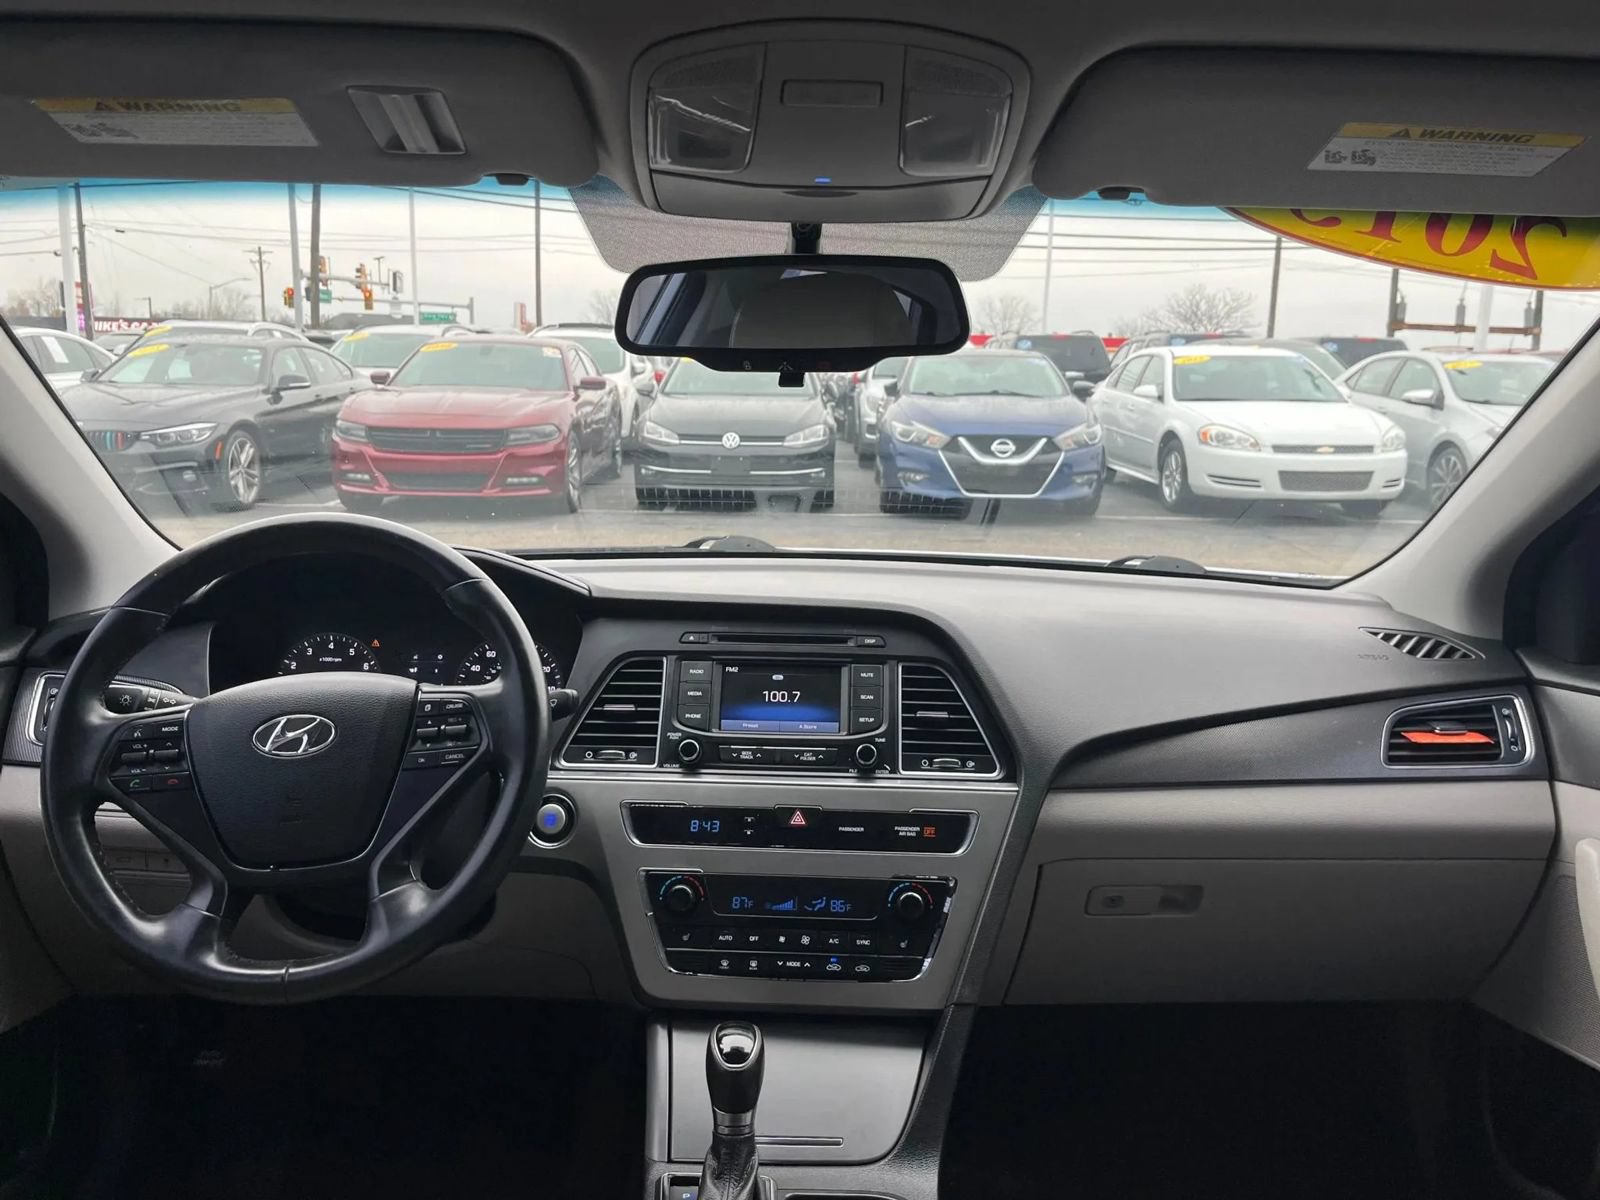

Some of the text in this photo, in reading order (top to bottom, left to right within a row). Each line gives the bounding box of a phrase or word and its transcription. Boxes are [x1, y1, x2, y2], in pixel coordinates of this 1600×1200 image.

[117, 101, 242, 112] WARNING
[1419, 128, 1537, 144] WARNING
[306, 648, 313, 656] 3
[349, 648, 355, 656] 5
[290, 661, 297, 670] 2
[363, 662, 370, 670] 6
[762, 690, 801, 703] 100.7
[690, 820, 720, 832] 8:43
